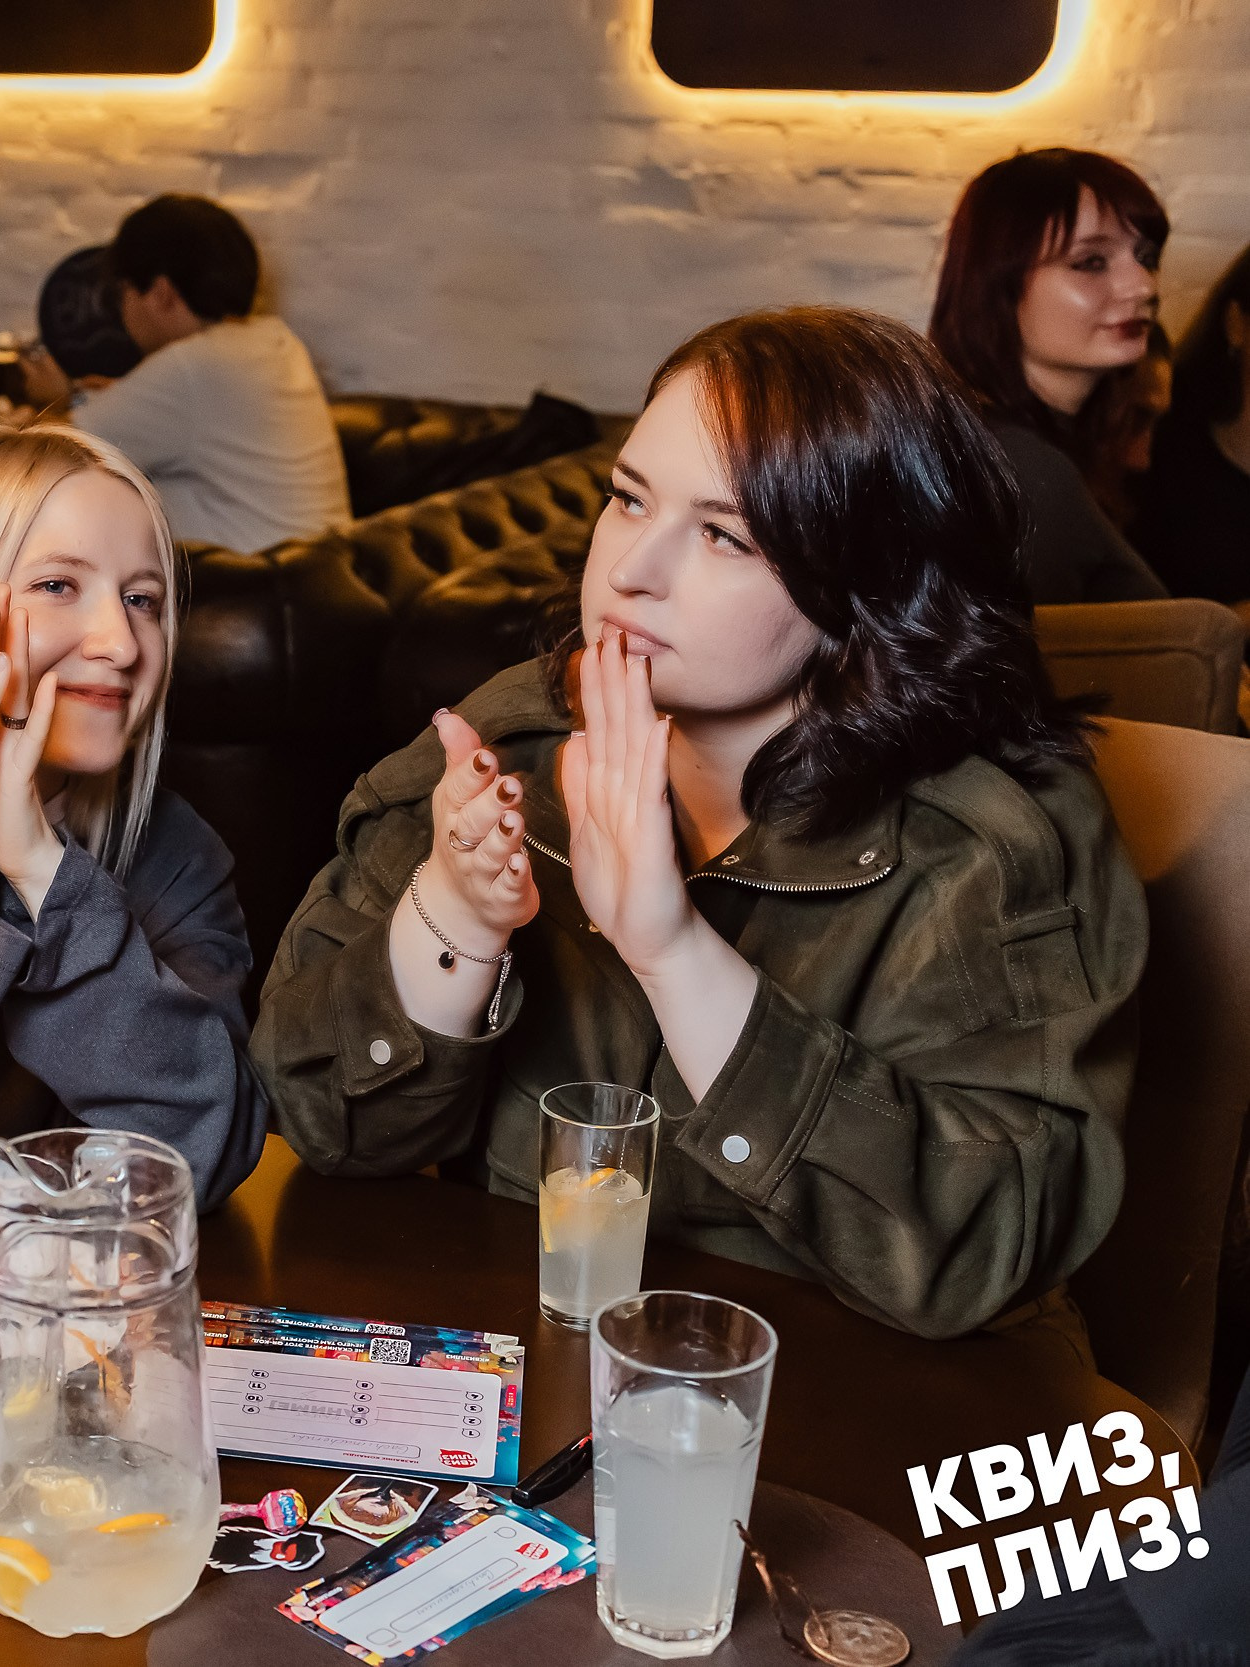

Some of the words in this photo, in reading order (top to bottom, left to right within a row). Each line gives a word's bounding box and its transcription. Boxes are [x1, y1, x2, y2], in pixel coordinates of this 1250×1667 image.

[331, 1325, 359, 1333] НЕЧЕГО
[280, 1336, 319, 1344] СМОТРЕТЬ
[304, 1343, 353, 1352] СКАНИРУЙТЕ
